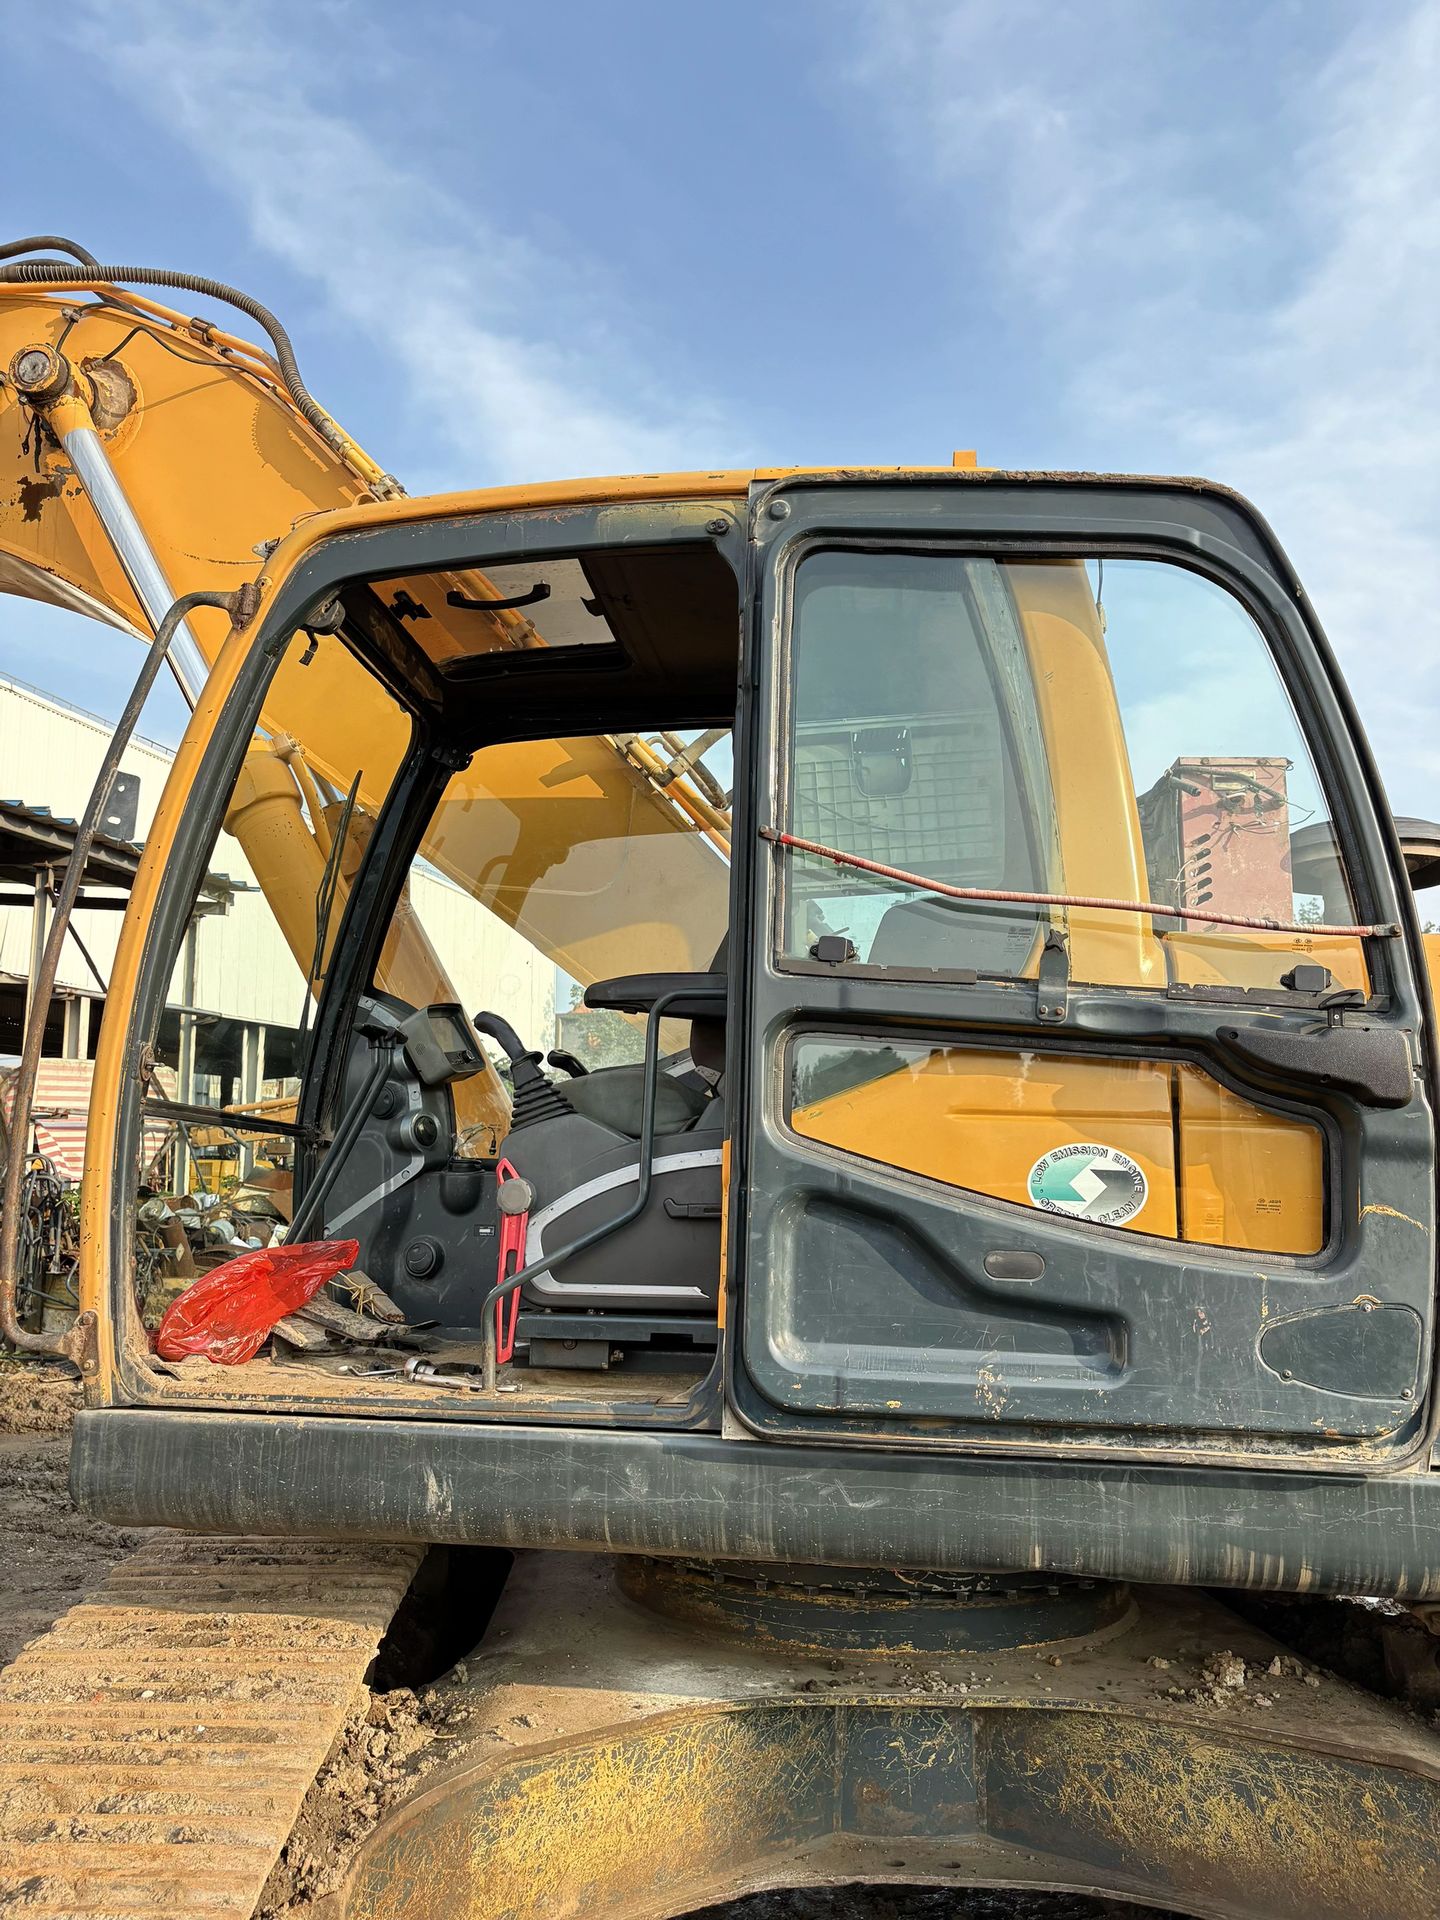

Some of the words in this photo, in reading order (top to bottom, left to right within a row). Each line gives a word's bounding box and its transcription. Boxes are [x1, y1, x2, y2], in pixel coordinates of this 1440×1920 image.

[1033, 1158, 1049, 1185] LOW
[1050, 1146, 1109, 1163] EMISSION
[1112, 1153, 1143, 1194] ENGINE
[1098, 1201, 1136, 1224] CLEAN
